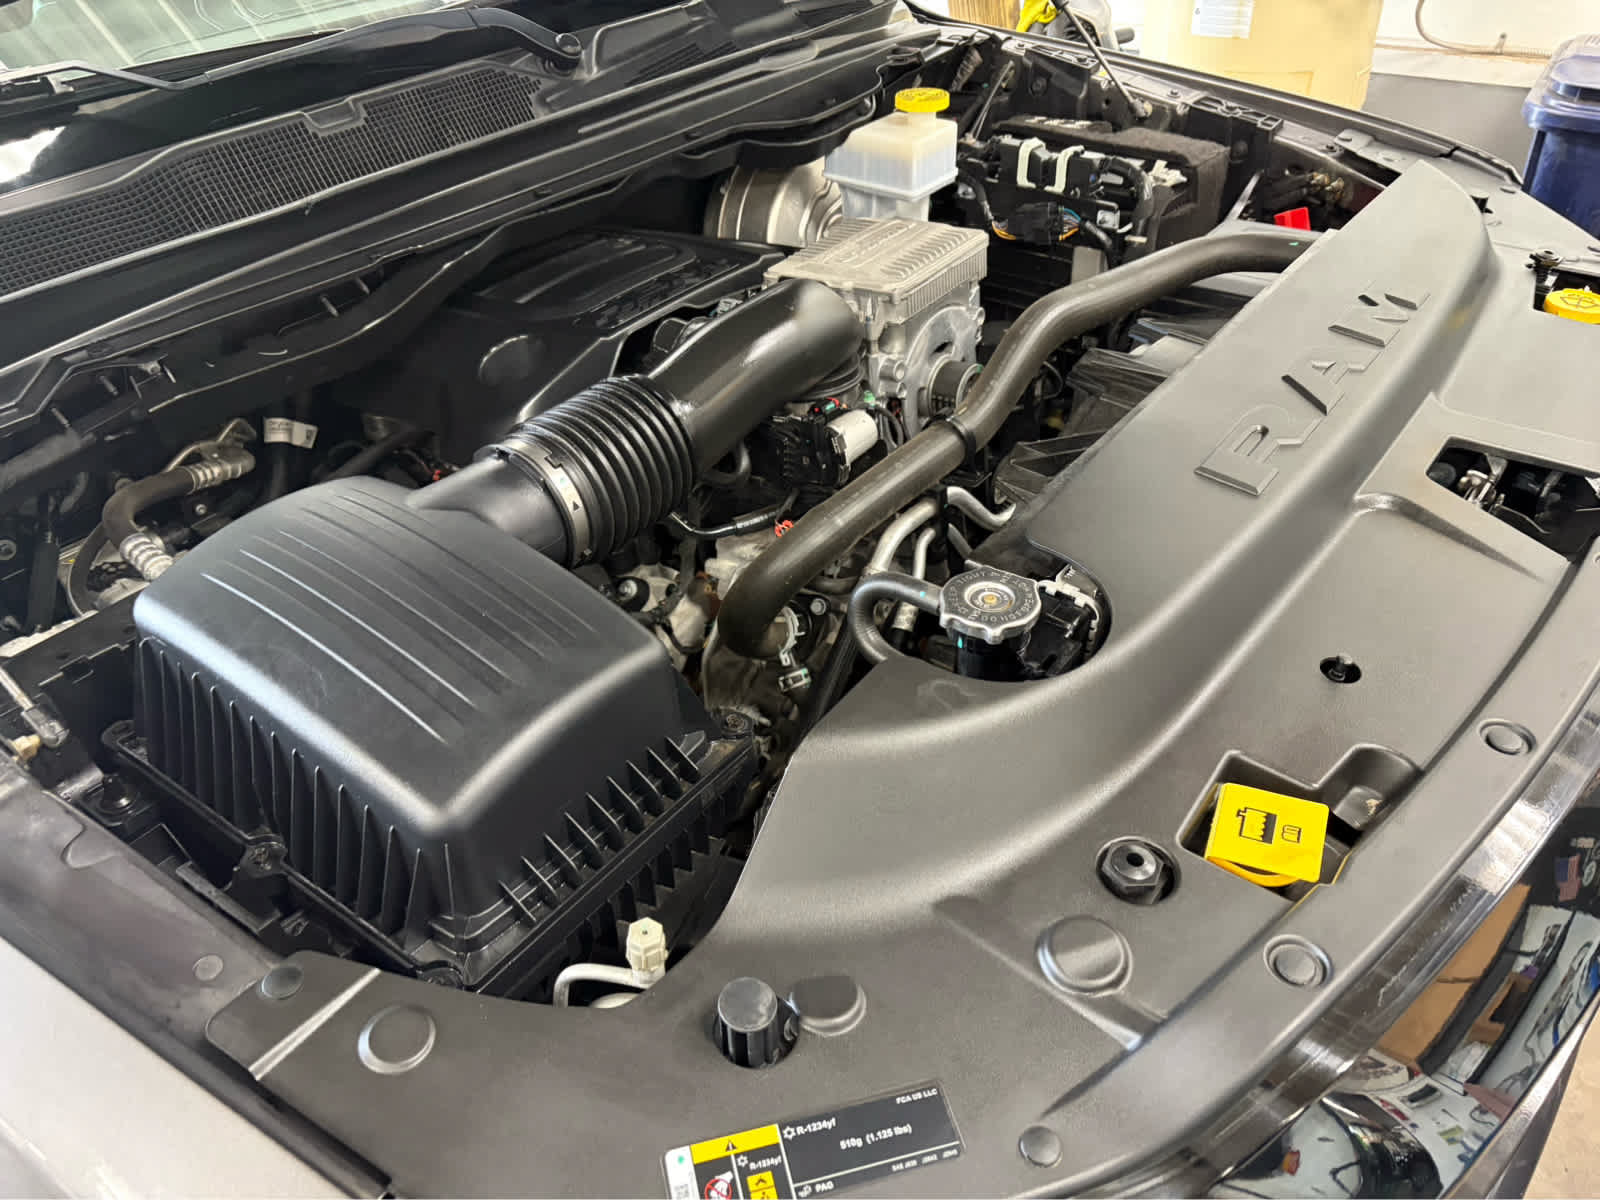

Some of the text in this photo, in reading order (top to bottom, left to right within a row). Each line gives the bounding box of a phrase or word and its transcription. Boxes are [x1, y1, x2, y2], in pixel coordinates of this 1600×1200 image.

[1194, 280, 1430, 496] RAM
[923, 1088, 938, 1098] LLC
[796, 1117, 836, 1135] R-1234yf
[866, 1128, 893, 1144] (1.125
[815, 1181, 834, 1192] PAG
